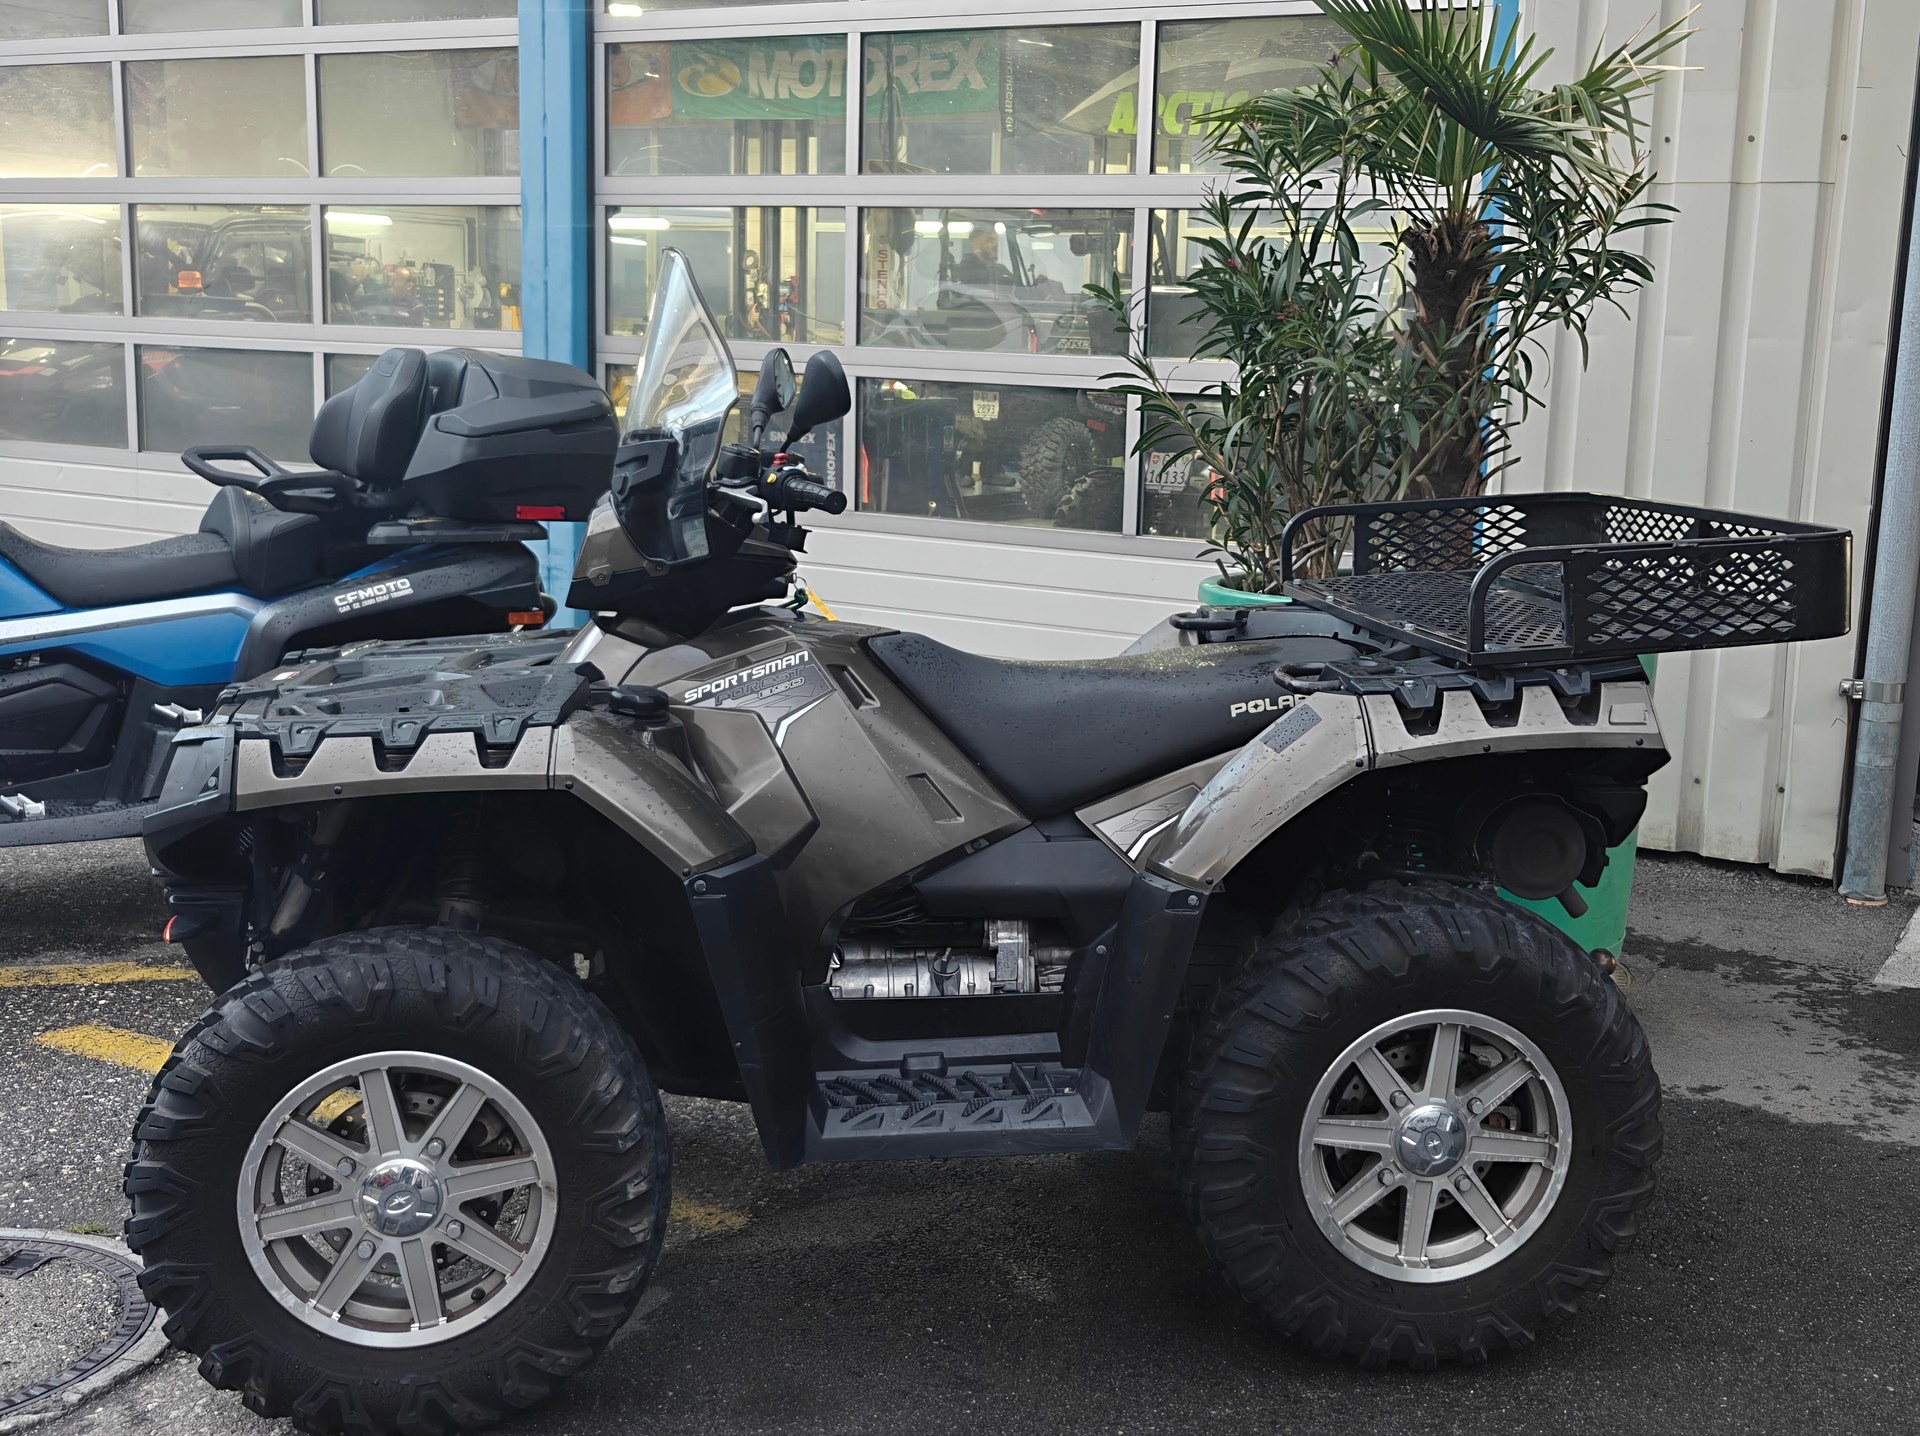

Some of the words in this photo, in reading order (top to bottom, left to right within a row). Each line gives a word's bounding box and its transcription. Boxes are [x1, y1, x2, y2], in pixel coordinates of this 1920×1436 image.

[748, 38, 987, 100] MOTOREX
[769, 430, 817, 444] SNEX
[826, 431, 837, 490] SNOPEX
[334, 578, 410, 605] CFMOTO
[684, 650, 809, 703] SPORTSMAN
[714, 665, 805, 706] FOREST
